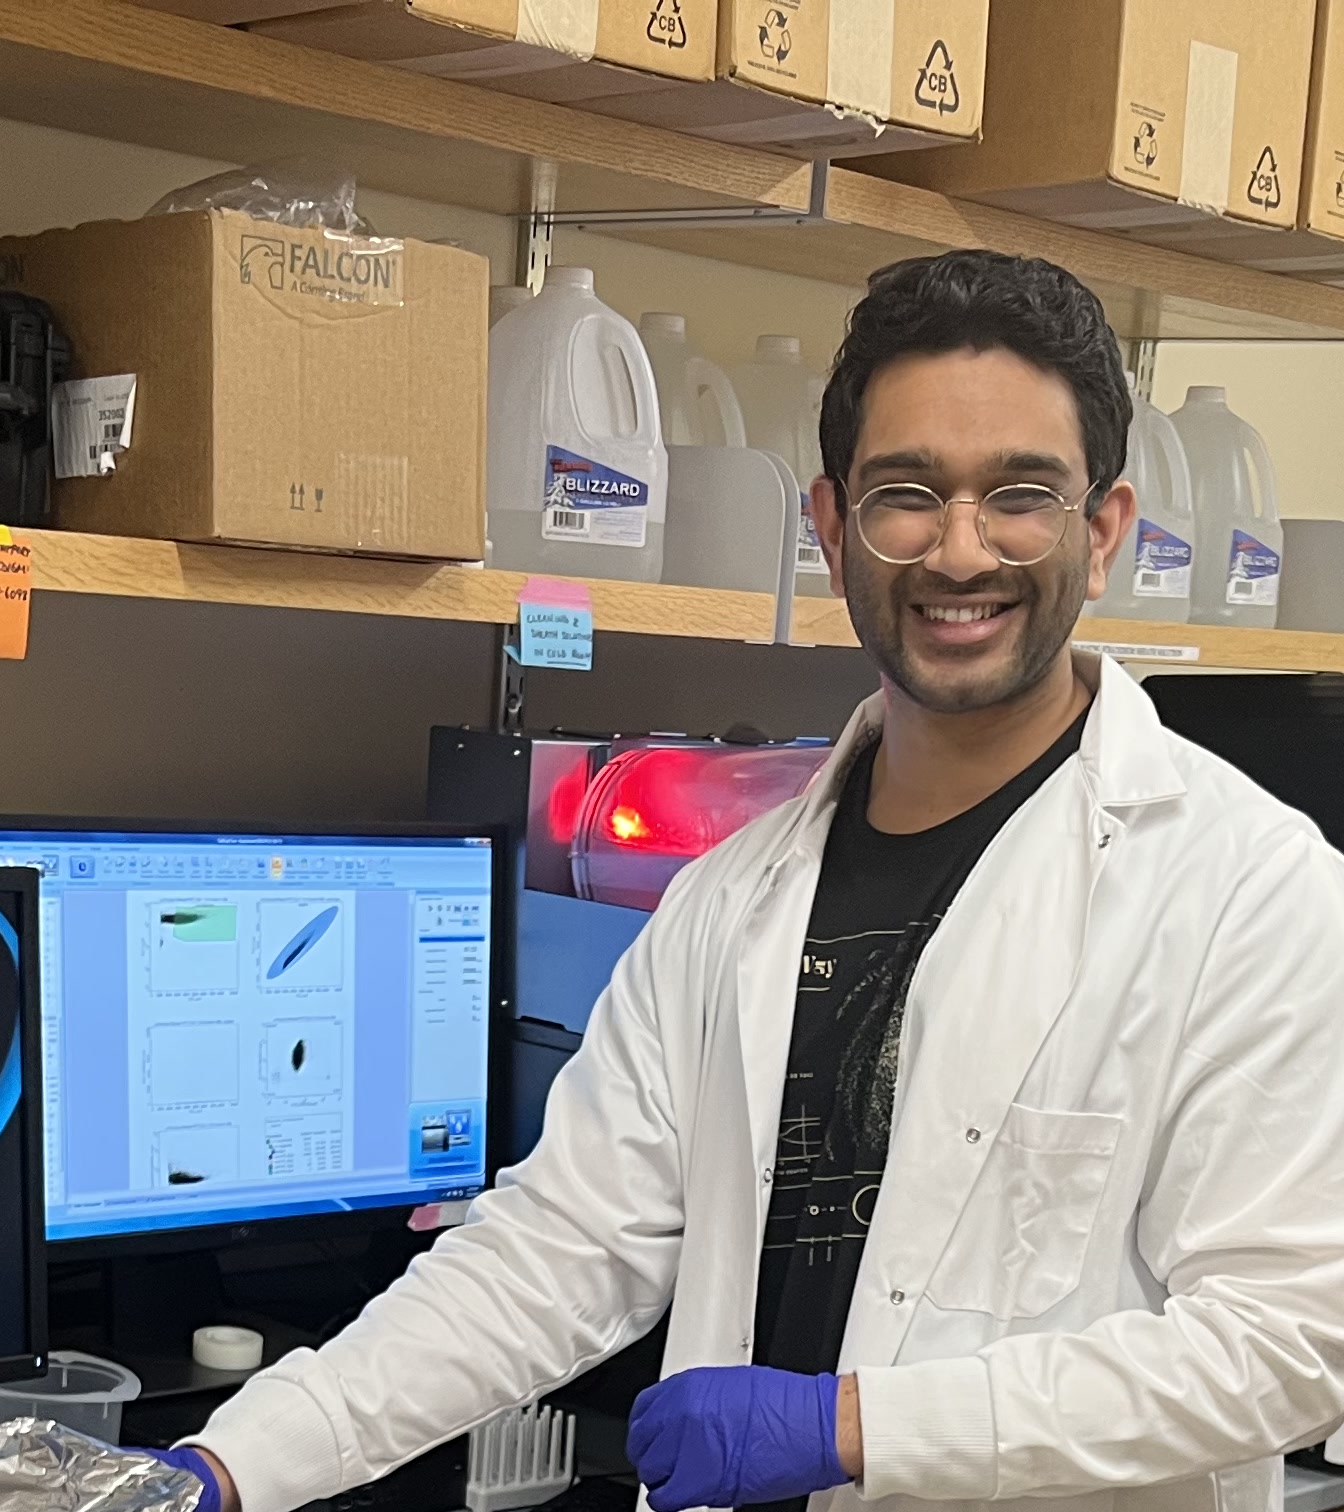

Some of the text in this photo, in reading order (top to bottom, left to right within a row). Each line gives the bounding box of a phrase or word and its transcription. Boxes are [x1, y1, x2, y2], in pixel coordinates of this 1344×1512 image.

[658, 14, 676, 33] CB
[928, 72, 948, 94] CB
[1256, 173, 1273, 193] CB
[289, 243, 392, 289] FALCON
[564, 477, 641, 498] BLIZZARD
